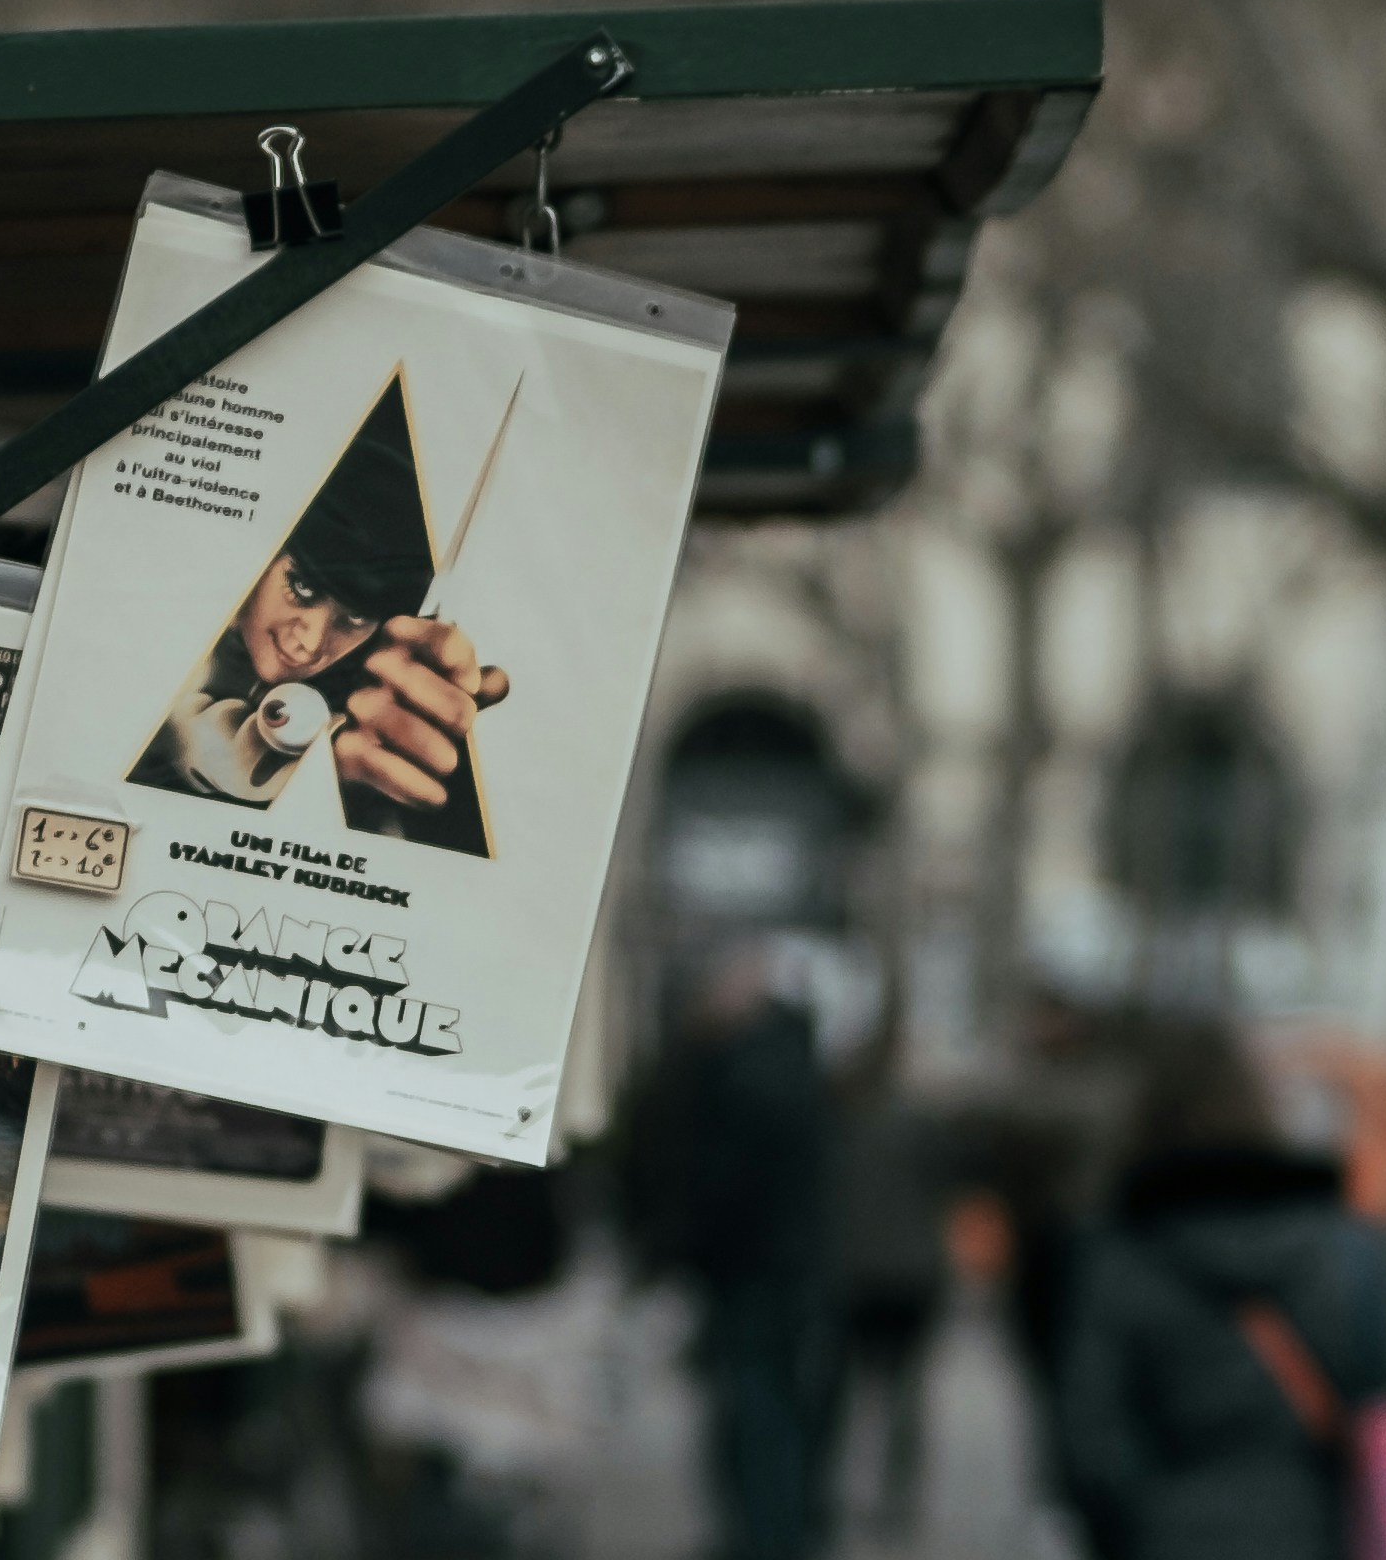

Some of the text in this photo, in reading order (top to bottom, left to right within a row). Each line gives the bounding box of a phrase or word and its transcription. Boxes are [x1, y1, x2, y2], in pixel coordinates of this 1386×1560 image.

[196, 374, 248, 394] stoire
[170, 409, 264, 439] s'intéresse
[221, 398, 285, 423] homme
[131, 422, 261, 460] principalement
[116, 459, 126, 473] à
[164, 451, 221, 472] au viol
[114, 481, 131, 494] et
[136, 484, 147, 498] à
[152, 488, 243, 520] Beethoven
[33, 818, 47, 843] 1
[231, 830, 367, 874] UN FILM DE
[169, 841, 411, 908] STANLEY KUBRICK
[122, 890, 410, 990] ORANGE
[69, 925, 463, 1055] MECANIQUE
